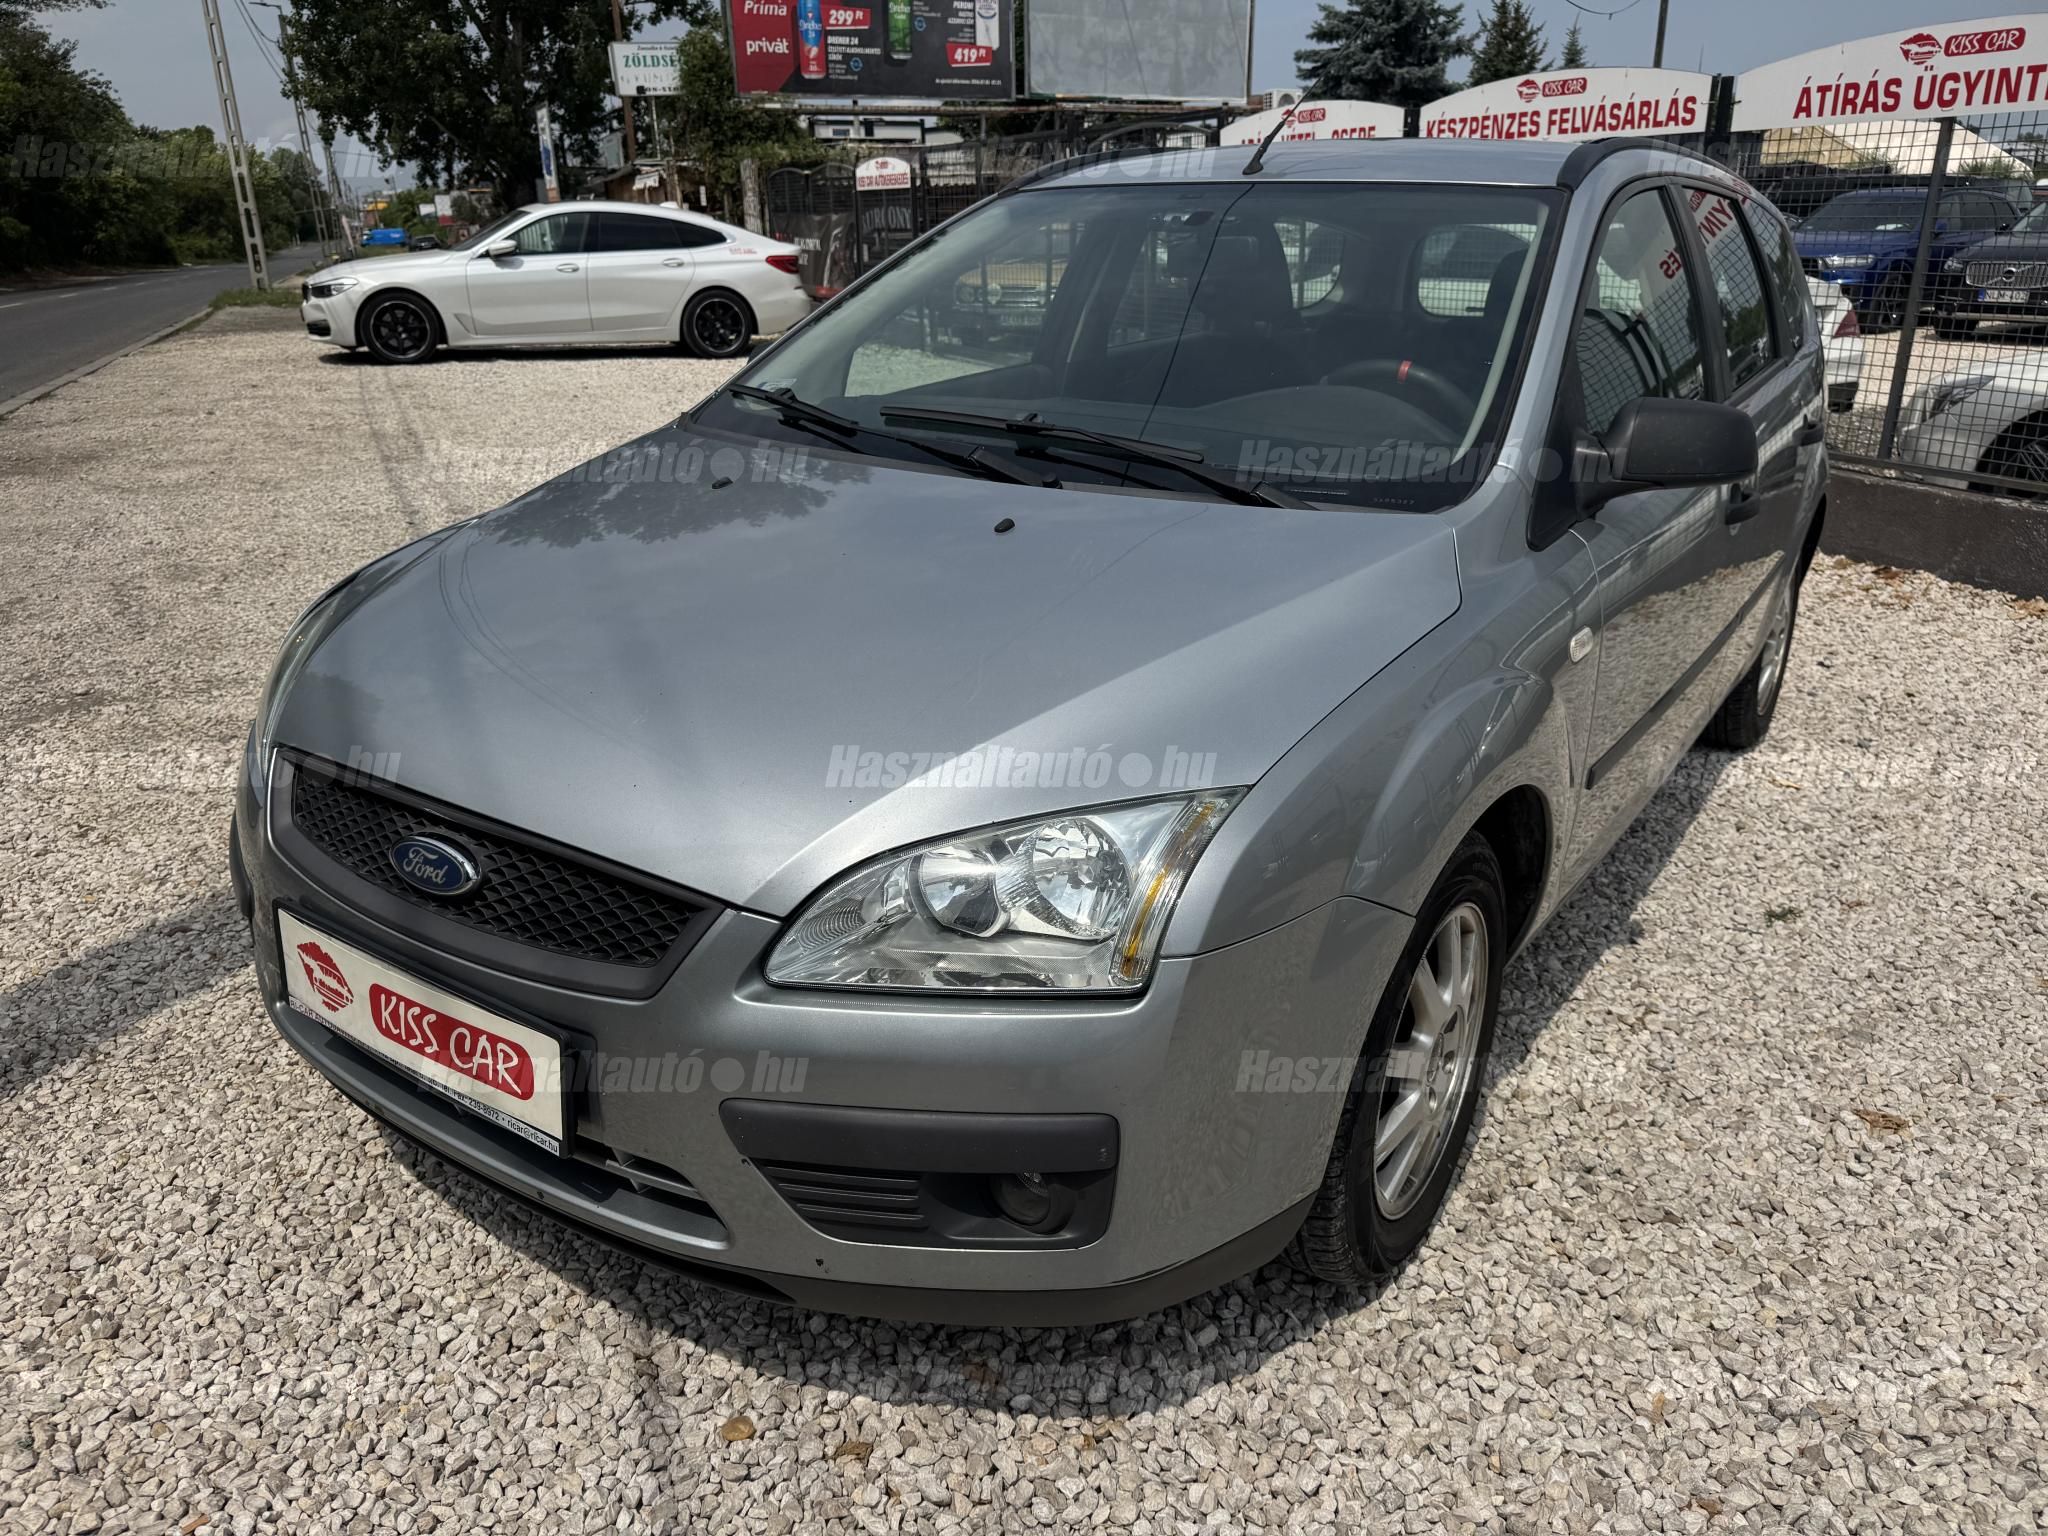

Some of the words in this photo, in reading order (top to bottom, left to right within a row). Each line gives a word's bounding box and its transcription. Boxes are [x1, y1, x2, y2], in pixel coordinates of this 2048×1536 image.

[829, 9, 854, 25] 299
[746, 37, 789, 55] privát
[954, 48, 977, 62] 419
[1949, 35, 1979, 54] KISS
[1985, 30, 2019, 51] CAR
[1544, 83, 1563, 95] KISS
[1565, 79, 1584, 94] CAR
[1793, 69, 1902, 119] ÁTÍRÁS
[1913, 64, 2048, 110] ÜGYINT
[1426, 106, 1541, 140] KÉSZPÉNZES
[1547, 88, 1697, 135] FELVÁSÁRLÁS
[403, 847, 448, 884] Ford
[380, 993, 440, 1053] KISS
[450, 1027, 522, 1095] CAR
[507, 1119, 558, 1154] ricar@ricar.hu
